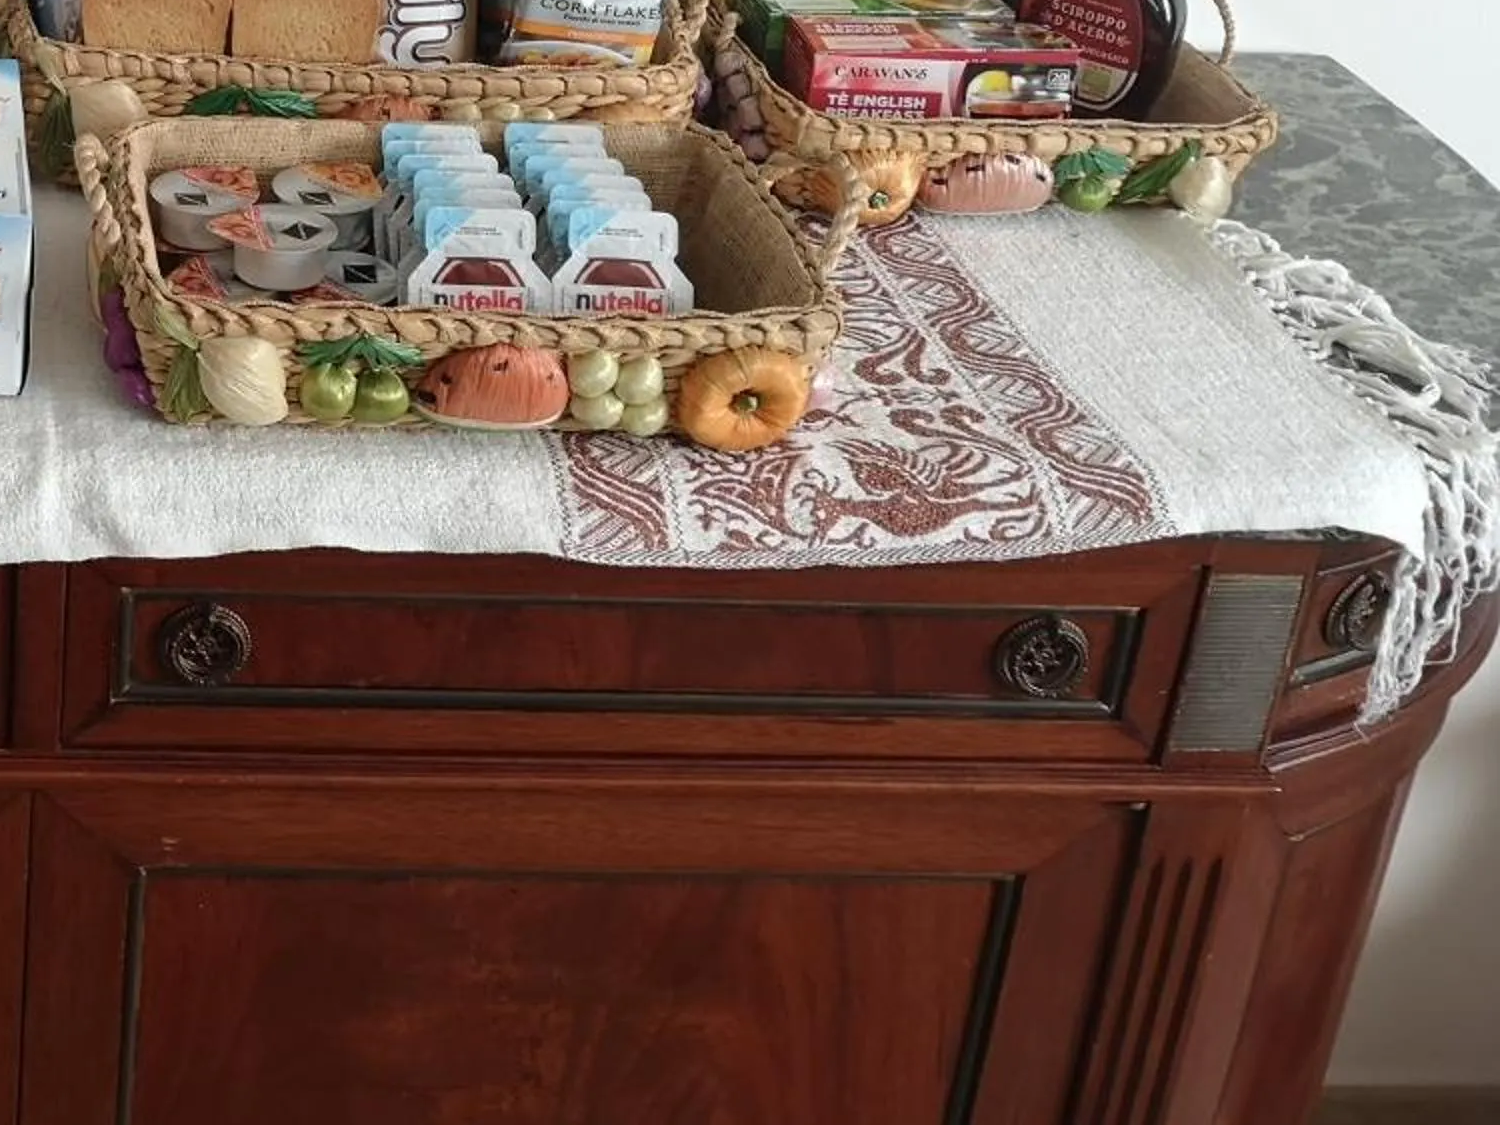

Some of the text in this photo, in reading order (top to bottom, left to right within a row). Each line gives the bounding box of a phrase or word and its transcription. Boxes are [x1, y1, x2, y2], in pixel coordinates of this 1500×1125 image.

[853, 94, 927, 109] ENGLISH
[434, 289, 523, 311] nutella
[576, 290, 664, 313] nutella
